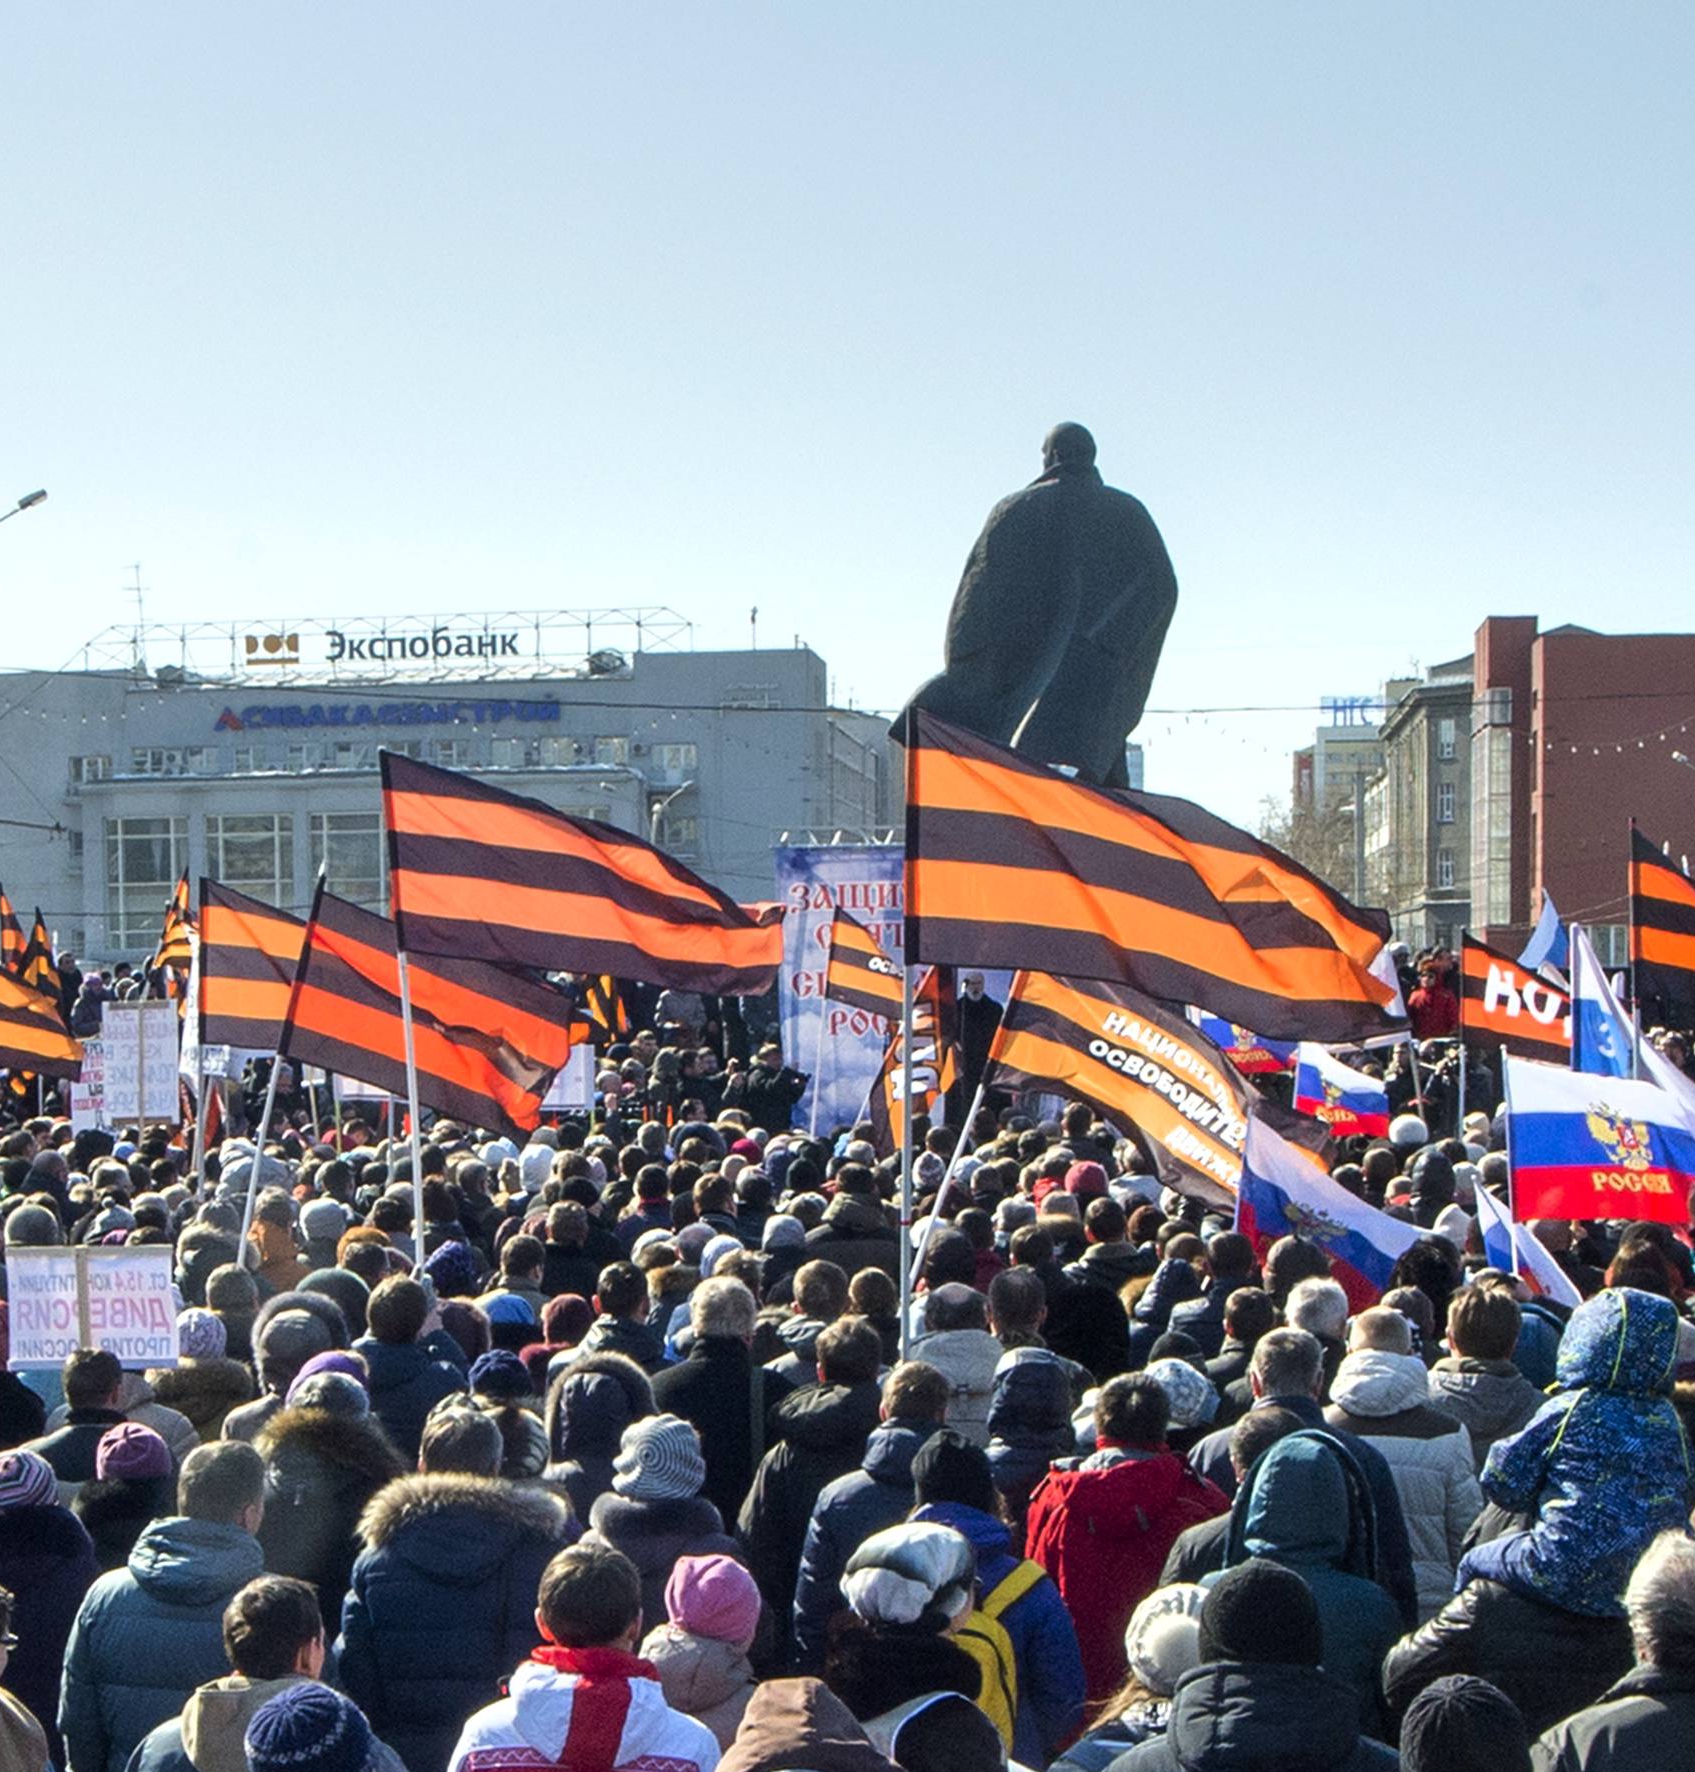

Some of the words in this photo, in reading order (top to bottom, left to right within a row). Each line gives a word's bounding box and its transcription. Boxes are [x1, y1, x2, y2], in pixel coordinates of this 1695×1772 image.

[325, 626, 519, 661] Экспобанк
[790, 882, 903, 915] ЗАЩИ
[1484, 963, 1572, 1039] НО
[1088, 1039, 1247, 1149] ОСВОБОДИТЕ
[1164, 1125, 1243, 1187] ДВИЖЕ
